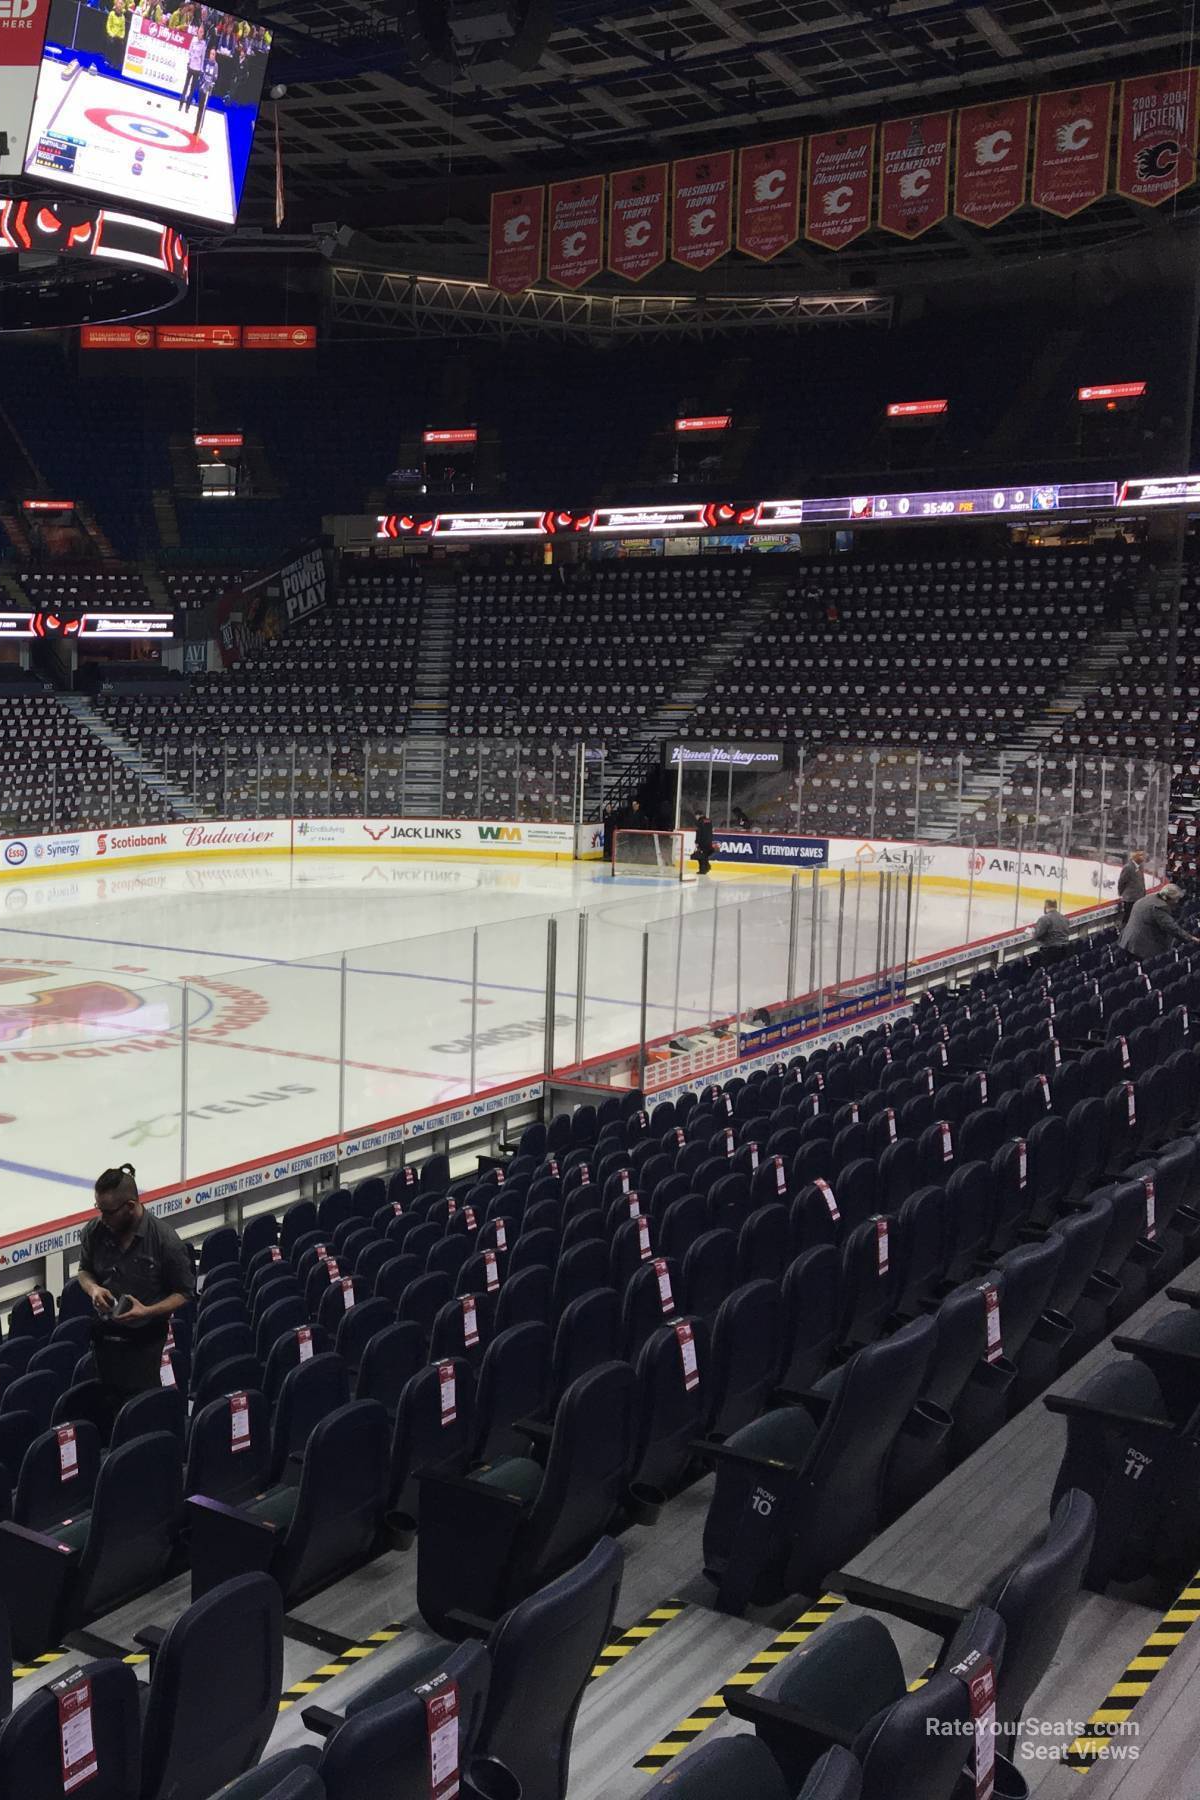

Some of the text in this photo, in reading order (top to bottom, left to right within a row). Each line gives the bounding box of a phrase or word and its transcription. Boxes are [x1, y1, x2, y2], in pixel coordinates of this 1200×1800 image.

[3, 20, 33, 28] HERE
[1133, 106, 1186, 142] WESTERN
[816, 145, 867, 165] Campbell
[885, 143, 946, 161] STANLEY CUP
[886, 156, 942, 174] CHAMPIONS
[813, 169, 869, 186] Champions
[923, 502, 954, 514] 35:40
[958, 502, 974, 512] PRE
[282, 560, 326, 598] POWER
[286, 580, 327, 623] PLAY
[111, 833, 167, 849] Scotiabank
[183, 826, 274, 847] Budweiser
[390, 826, 420, 839] JACK
[478, 827, 522, 840] WM
[8, 849, 25, 859] Esso
[46, 842, 80, 857] Synergy
[720, 841, 753, 855] AMA
[762, 844, 824, 859] EVERYDAY SAVES
[177, 1082, 318, 1121] TELUS
[346, 1140, 361, 1156] OPA!
[362, 1134, 382, 1151] KEEPING
[388, 1128, 403, 1143] FRESH
[274, 1147, 336, 1180] OPA! KEEPING IT FRESH
[195, 1170, 264, 1205] OPA! KEEPING IT FRESH
[156, 1196, 183, 1217] IT FRESH
[11, 1243, 32, 1264] OPA!
[35, 1235, 64, 1256] KEEPING
[64, 1233, 72, 1245] IT
[1126, 1447, 1153, 1466] ROW
[1124, 1458, 1145, 1480] 11
[755, 1486, 777, 1503] ROW
[751, 1494, 773, 1516] 10
